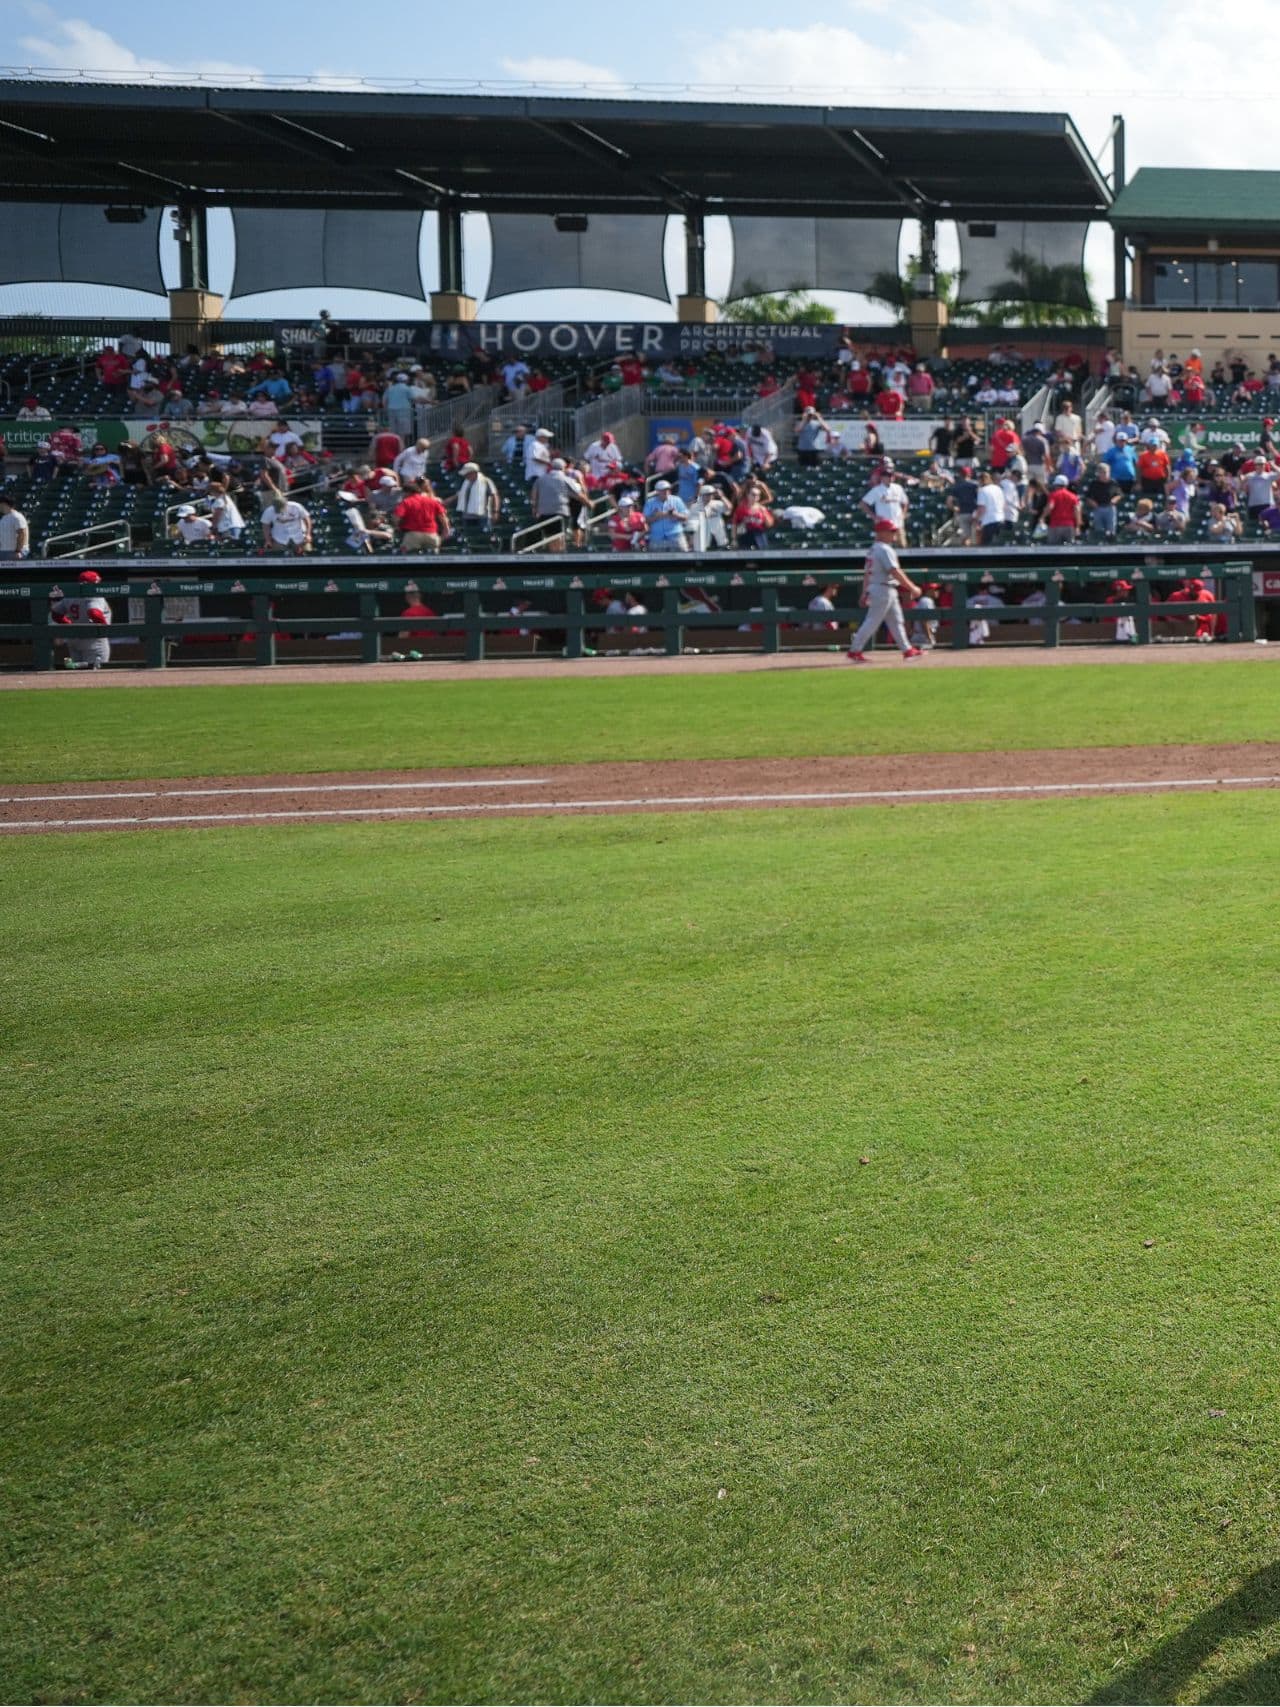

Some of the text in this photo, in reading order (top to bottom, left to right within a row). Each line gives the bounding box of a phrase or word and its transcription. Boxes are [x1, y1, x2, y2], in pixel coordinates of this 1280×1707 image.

[281, 328, 416, 344] SHAD VIDED BY
[480, 323, 664, 351] HOOVER
[681, 325, 823, 339] ARCHITECTURAL
